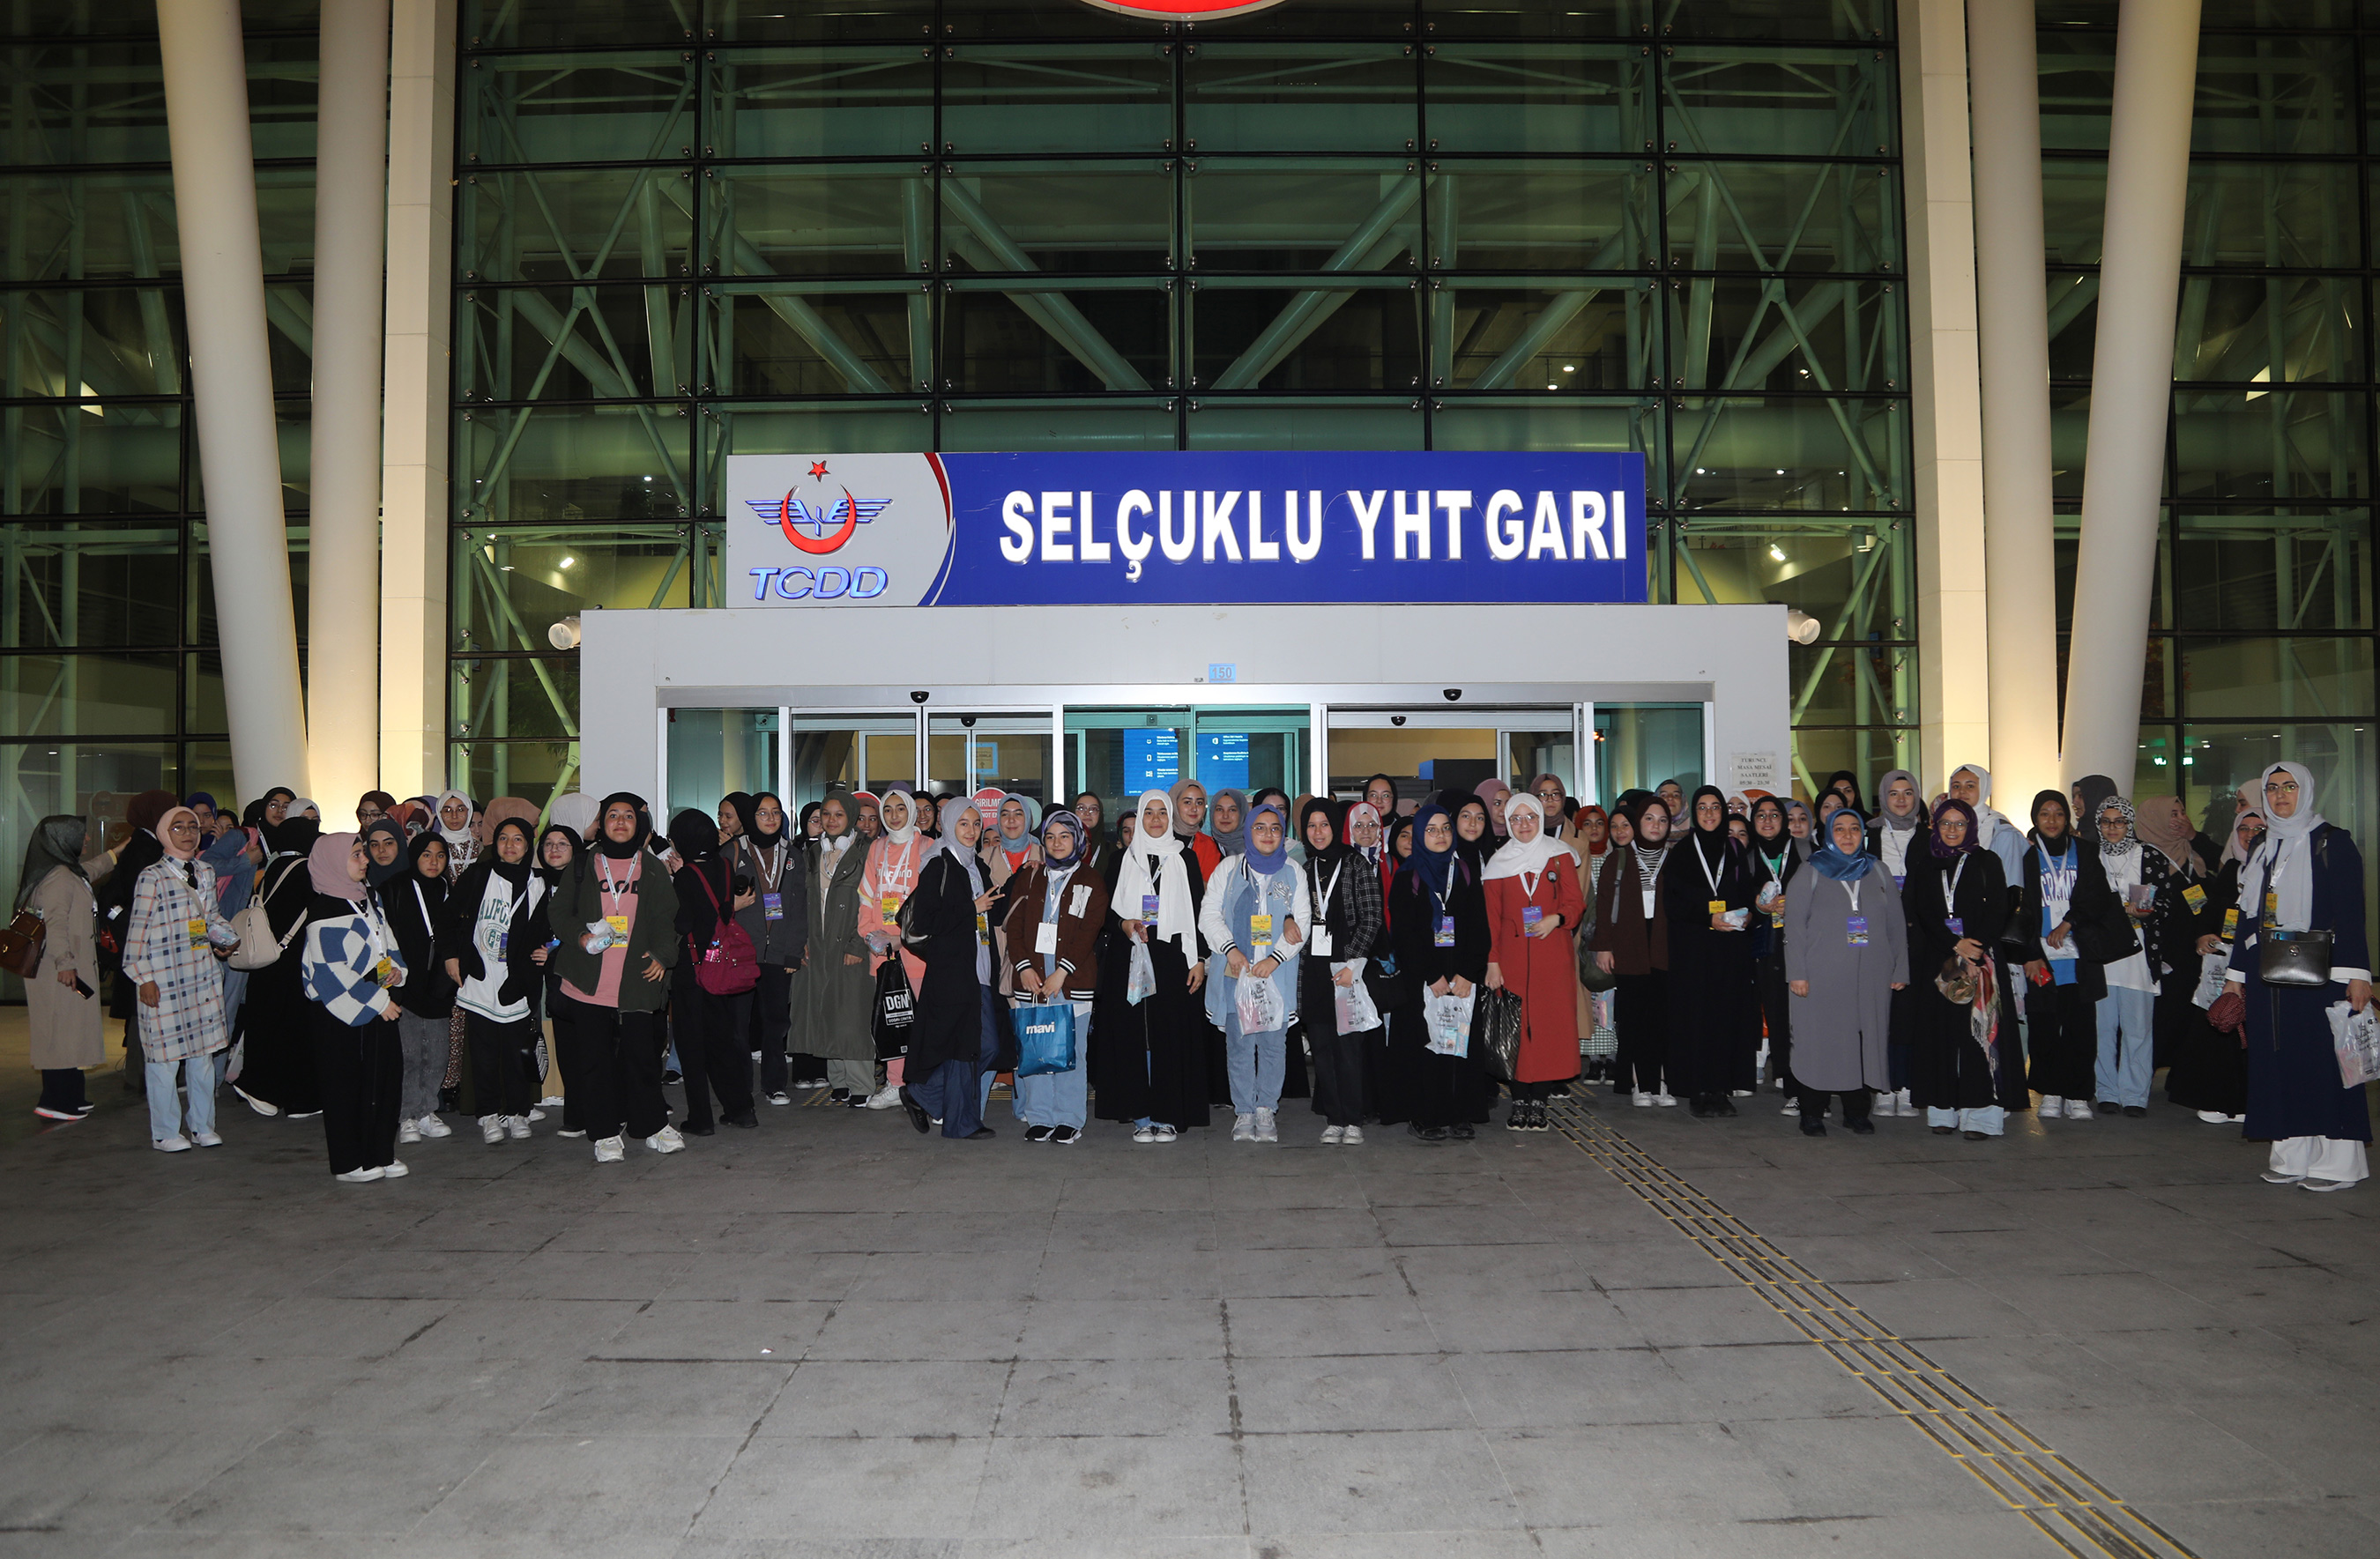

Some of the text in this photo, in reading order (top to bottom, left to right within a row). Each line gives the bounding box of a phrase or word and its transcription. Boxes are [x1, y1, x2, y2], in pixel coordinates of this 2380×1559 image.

[1000, 489, 1627, 583] SELÇUKLU YHT GARI
[749, 566, 888, 600] TCDD
[1212, 667, 1232, 679] 150
[885, 994, 909, 1011] DGN
[1026, 1021, 1055, 1035] mavi
